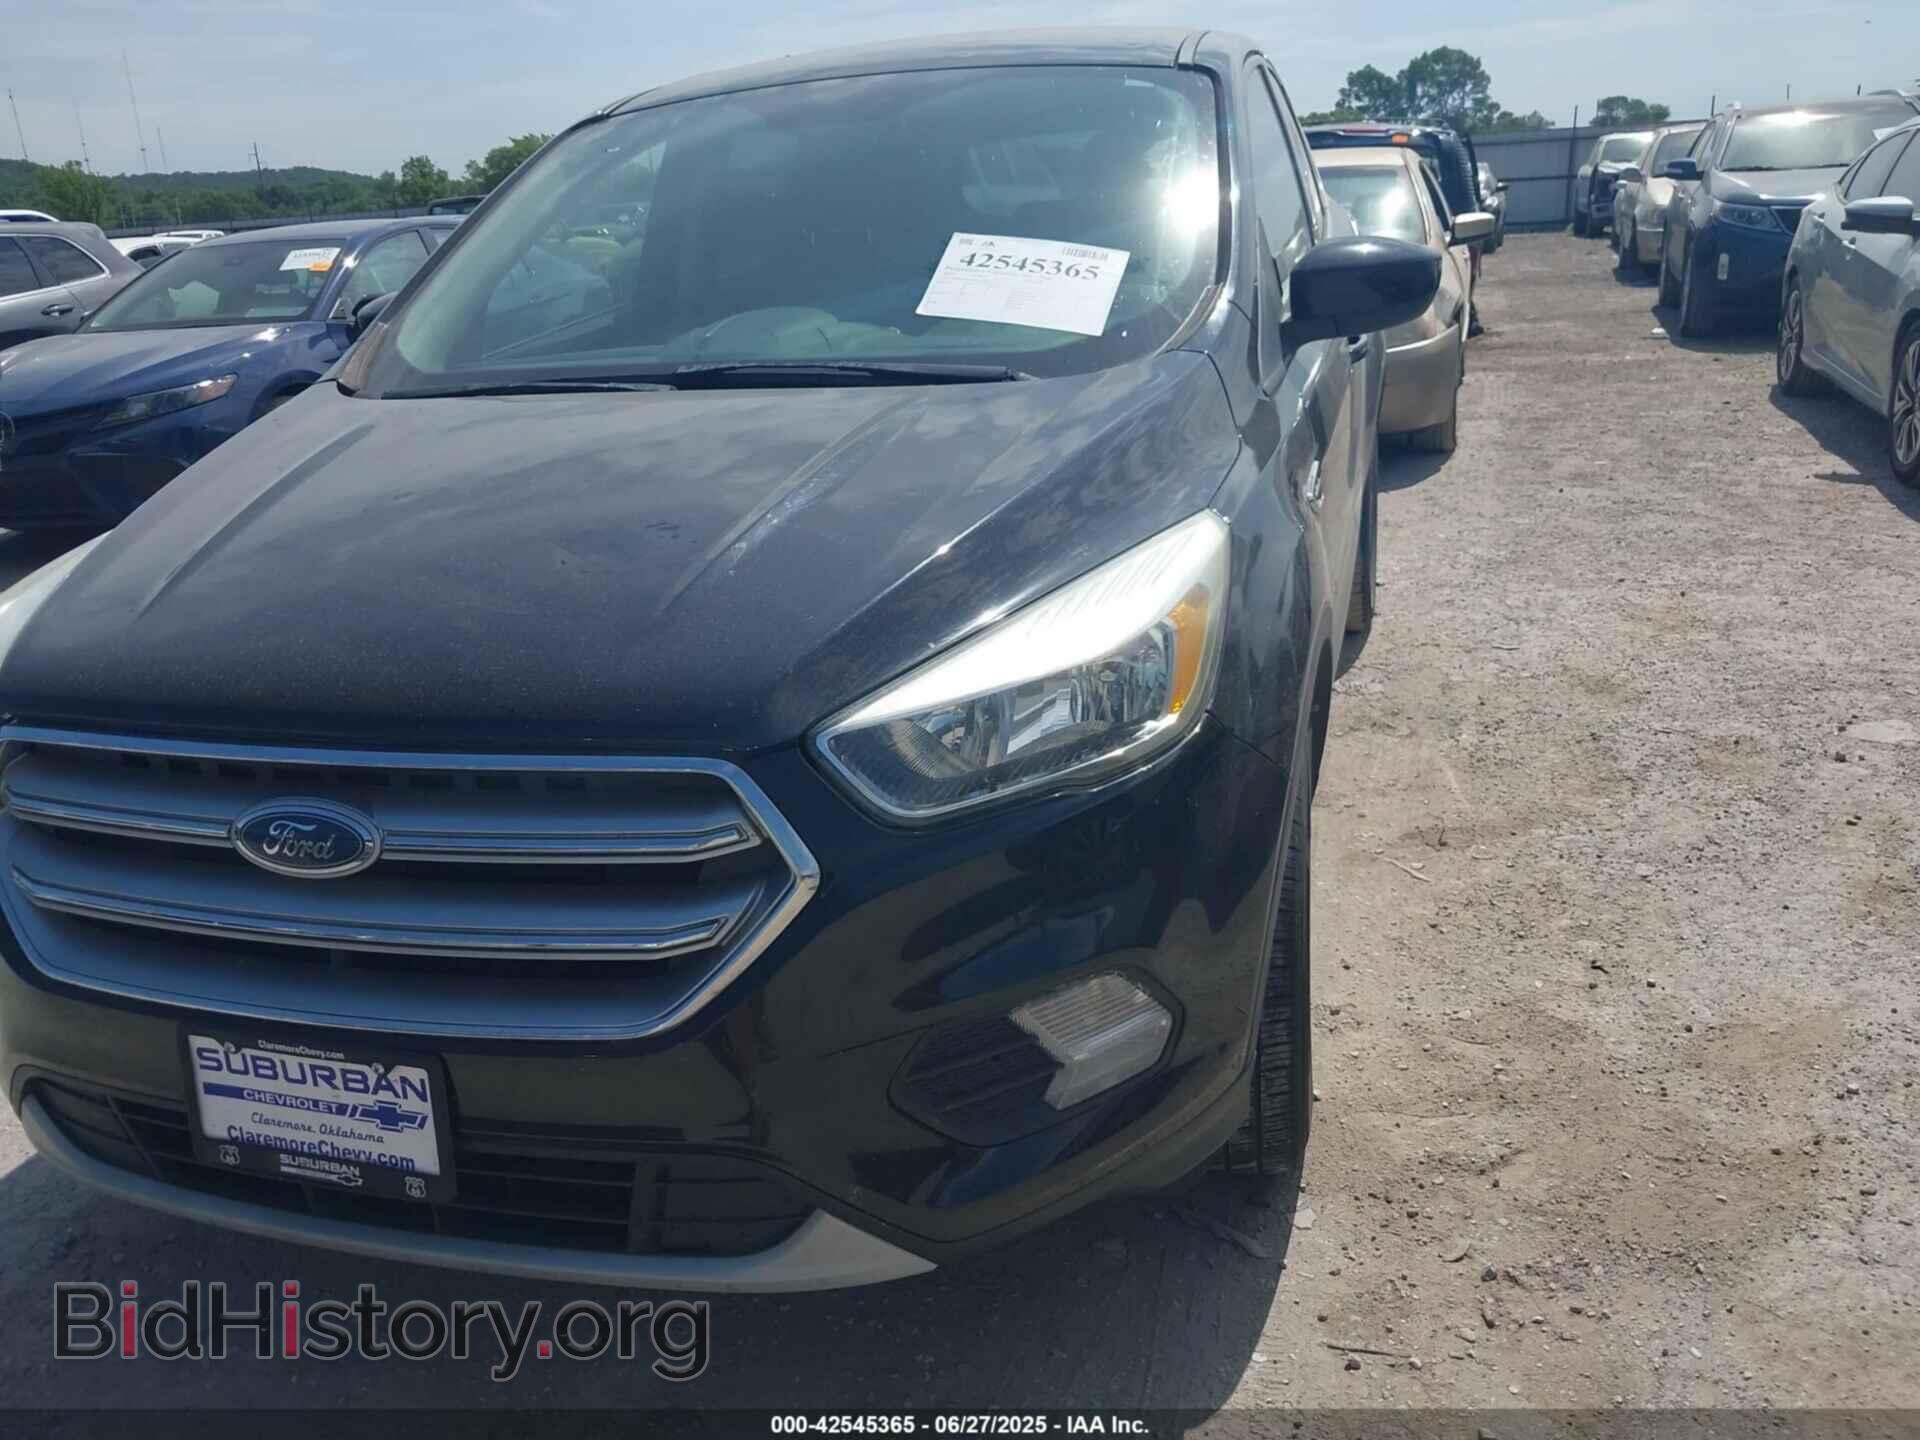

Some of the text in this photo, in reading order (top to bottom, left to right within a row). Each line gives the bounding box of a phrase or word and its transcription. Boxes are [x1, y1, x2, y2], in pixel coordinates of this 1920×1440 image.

[959, 251, 1100, 281] 42545365
[263, 820, 336, 859] Ford
[257, 1039, 345, 1061] ClaremoreChevy.com
[197, 1047, 428, 1102] SUBURBAN
[243, 1089, 339, 1114] CHEVROLET
[319, 1123, 385, 1145] Oklahoma
[227, 1125, 416, 1171] ClaremoreChevy.com
[279, 1153, 360, 1177] SUBURBAN
